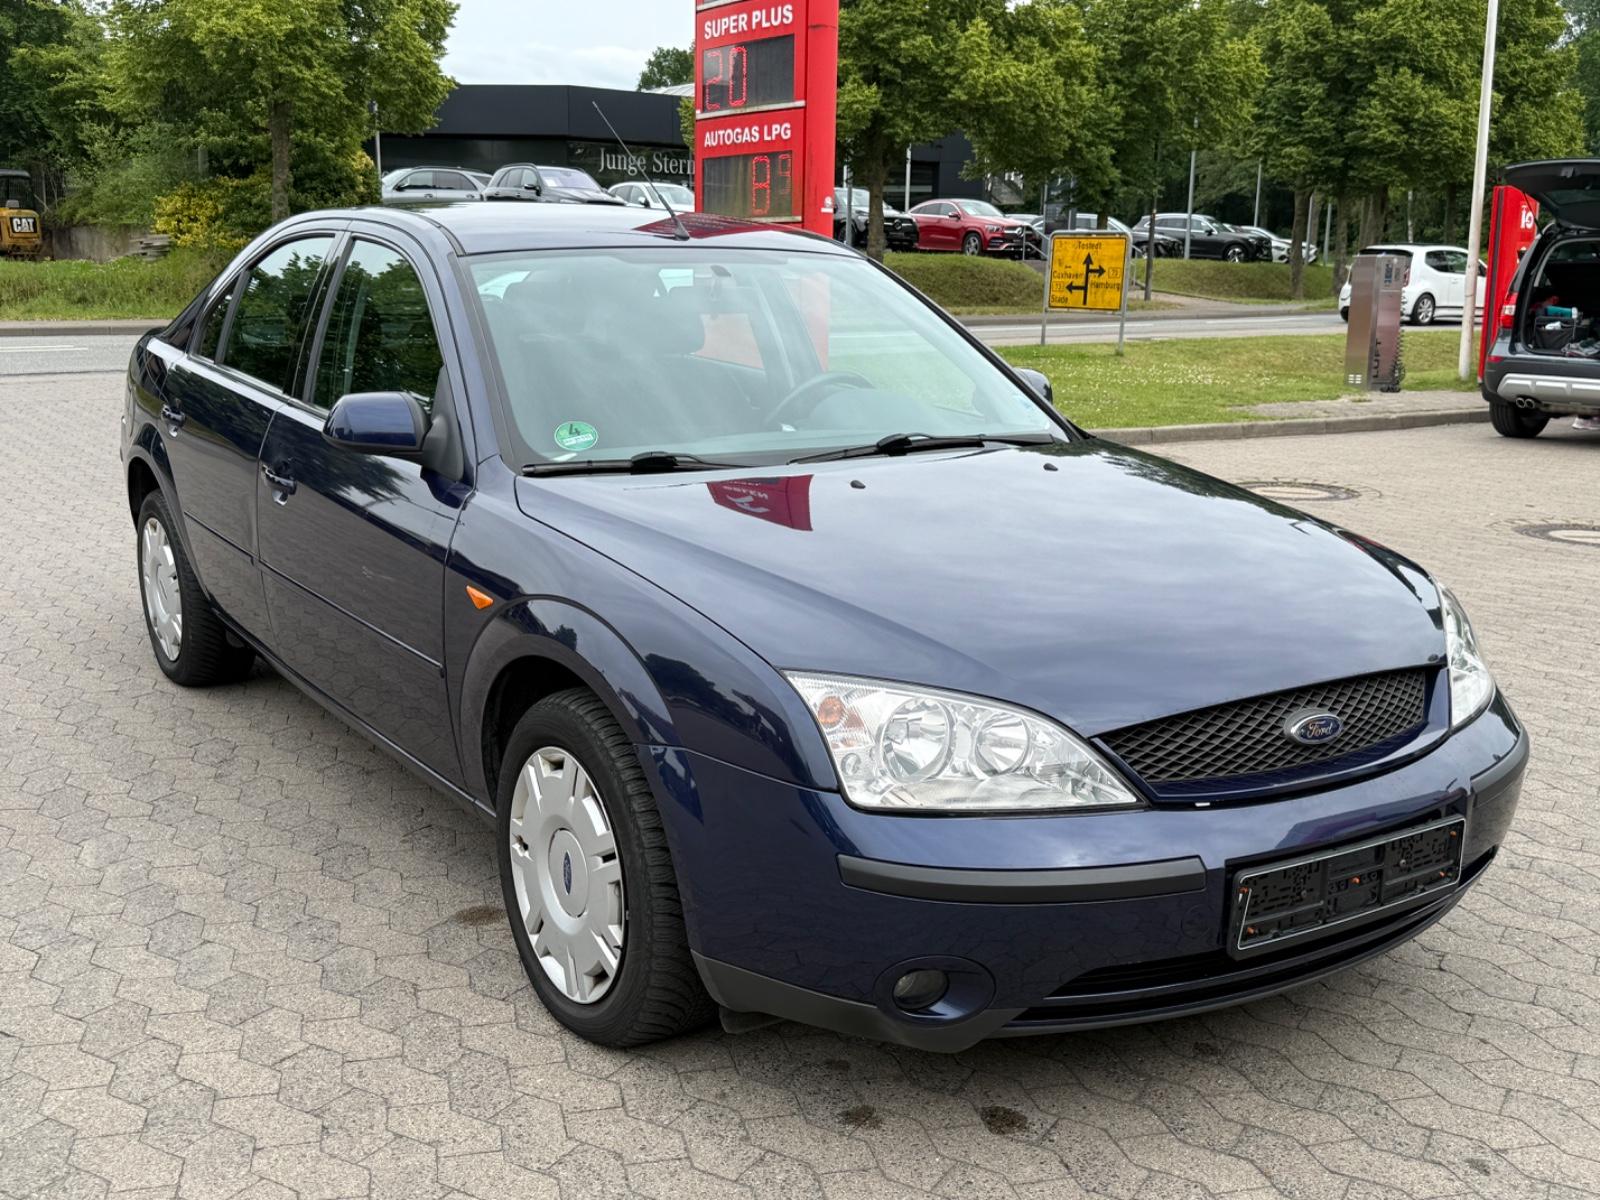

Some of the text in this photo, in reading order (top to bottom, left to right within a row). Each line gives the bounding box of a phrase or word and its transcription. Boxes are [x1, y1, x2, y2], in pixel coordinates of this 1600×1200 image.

[704, 4, 793, 39] SUPER PLUS
[704, 122, 791, 147] AUTOGAS LPG
[599, 147, 647, 176] Junge
[13, 218, 34, 232] CAT
[1306, 720, 1334, 738] Ford
